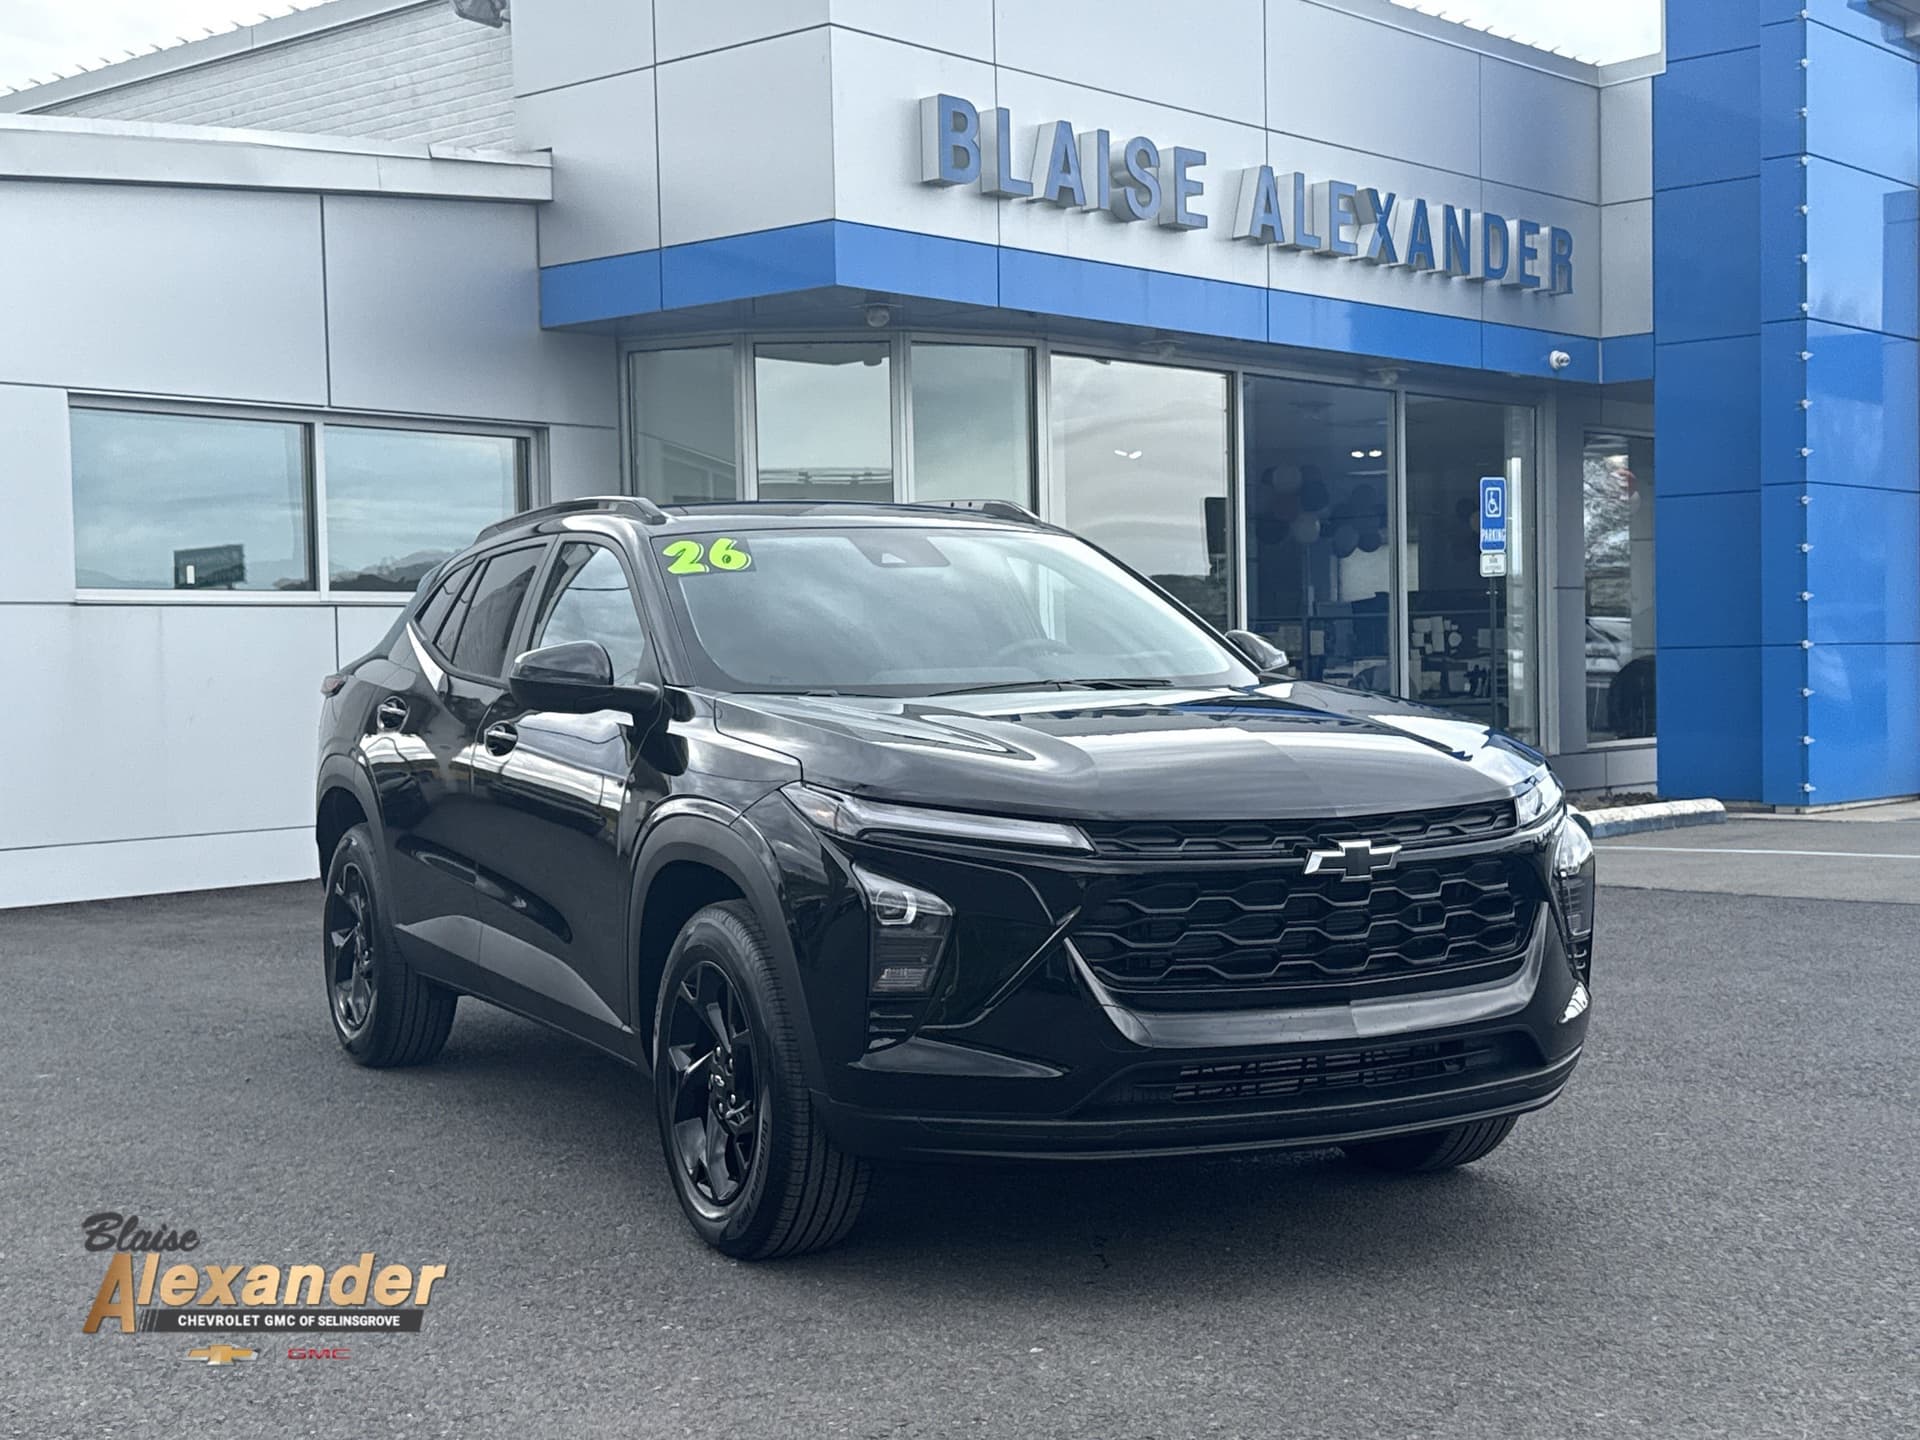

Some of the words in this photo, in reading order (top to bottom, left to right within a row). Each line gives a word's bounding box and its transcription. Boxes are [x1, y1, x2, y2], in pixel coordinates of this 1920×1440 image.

[921, 93, 1208, 230] BLAISE
[1236, 164, 1573, 294] ALEXANDER
[662, 537, 752, 575] 26
